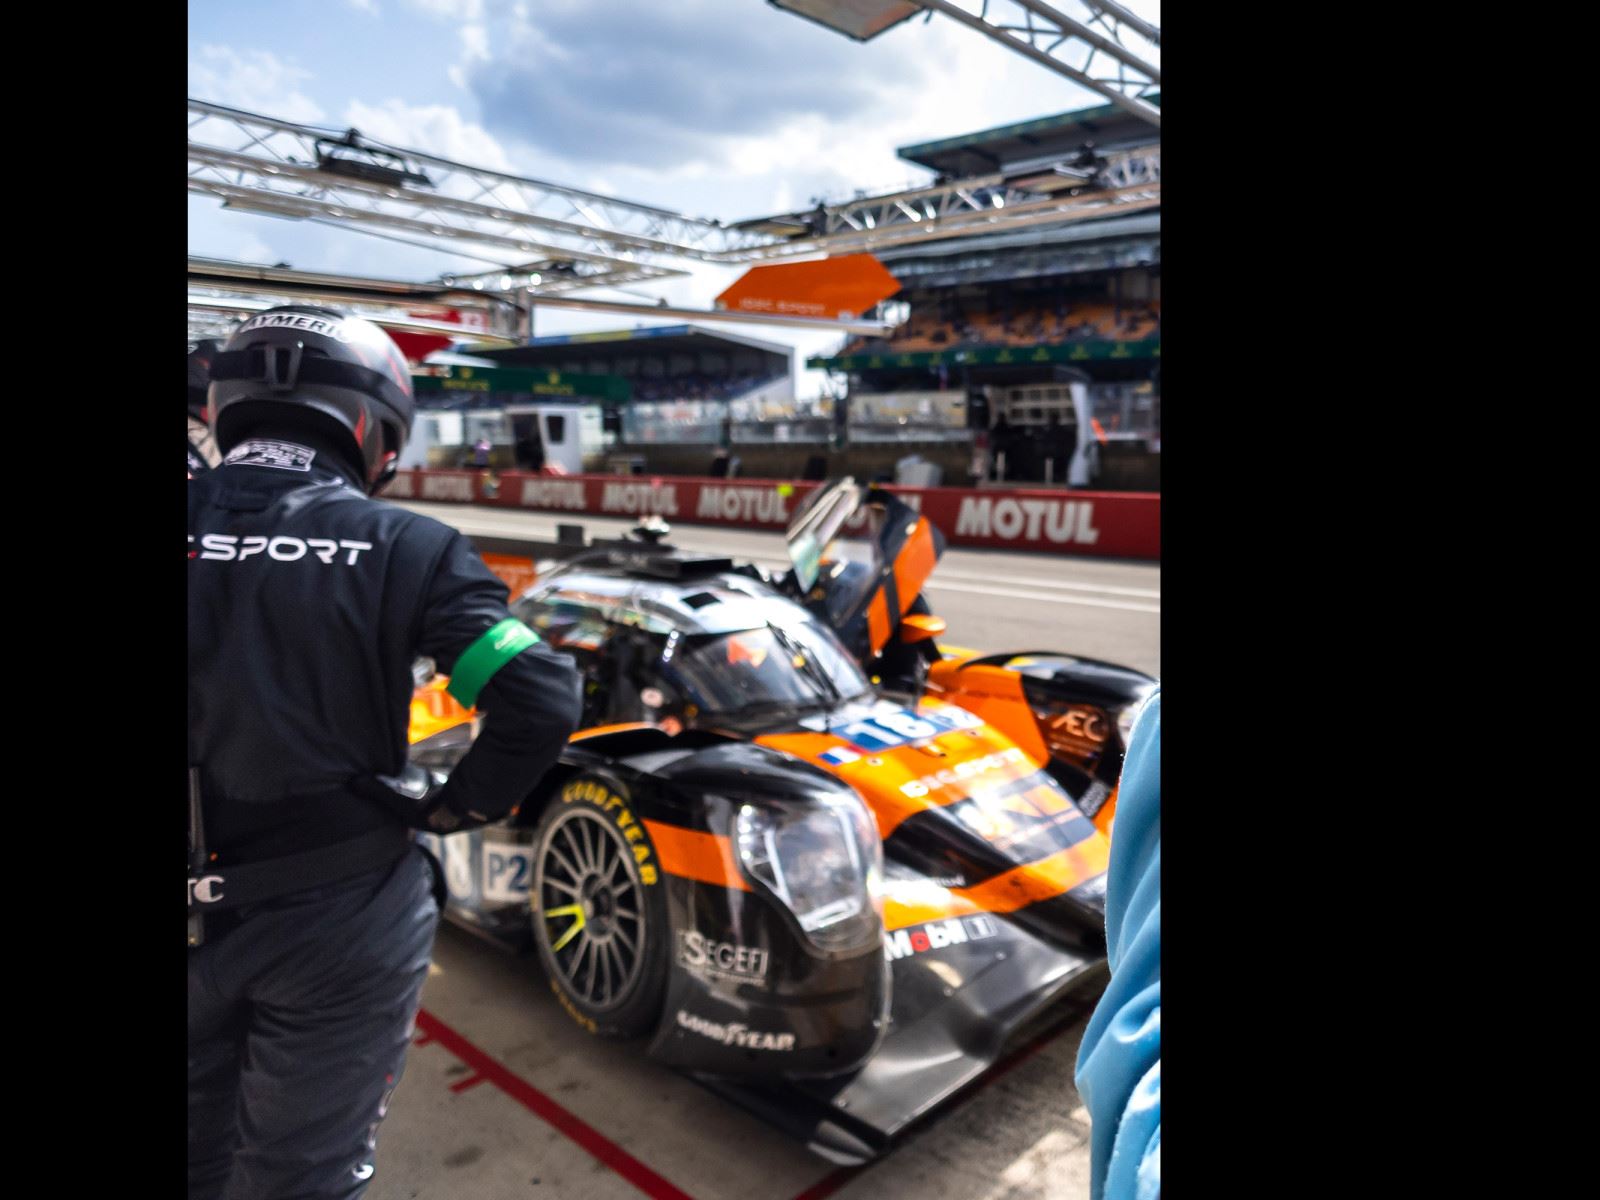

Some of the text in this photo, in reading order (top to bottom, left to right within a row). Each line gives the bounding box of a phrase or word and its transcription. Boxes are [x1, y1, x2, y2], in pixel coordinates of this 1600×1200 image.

[602, 482, 679, 515] MOTUL
[696, 486, 790, 523] MOTUL
[956, 496, 1099, 545] MOTUL
[562, 780, 658, 887] GOODYEAR
[489, 853, 529, 893] P2
[882, 916, 969, 962] Mobil
[676, 1009, 796, 1051] GOODYEAR
